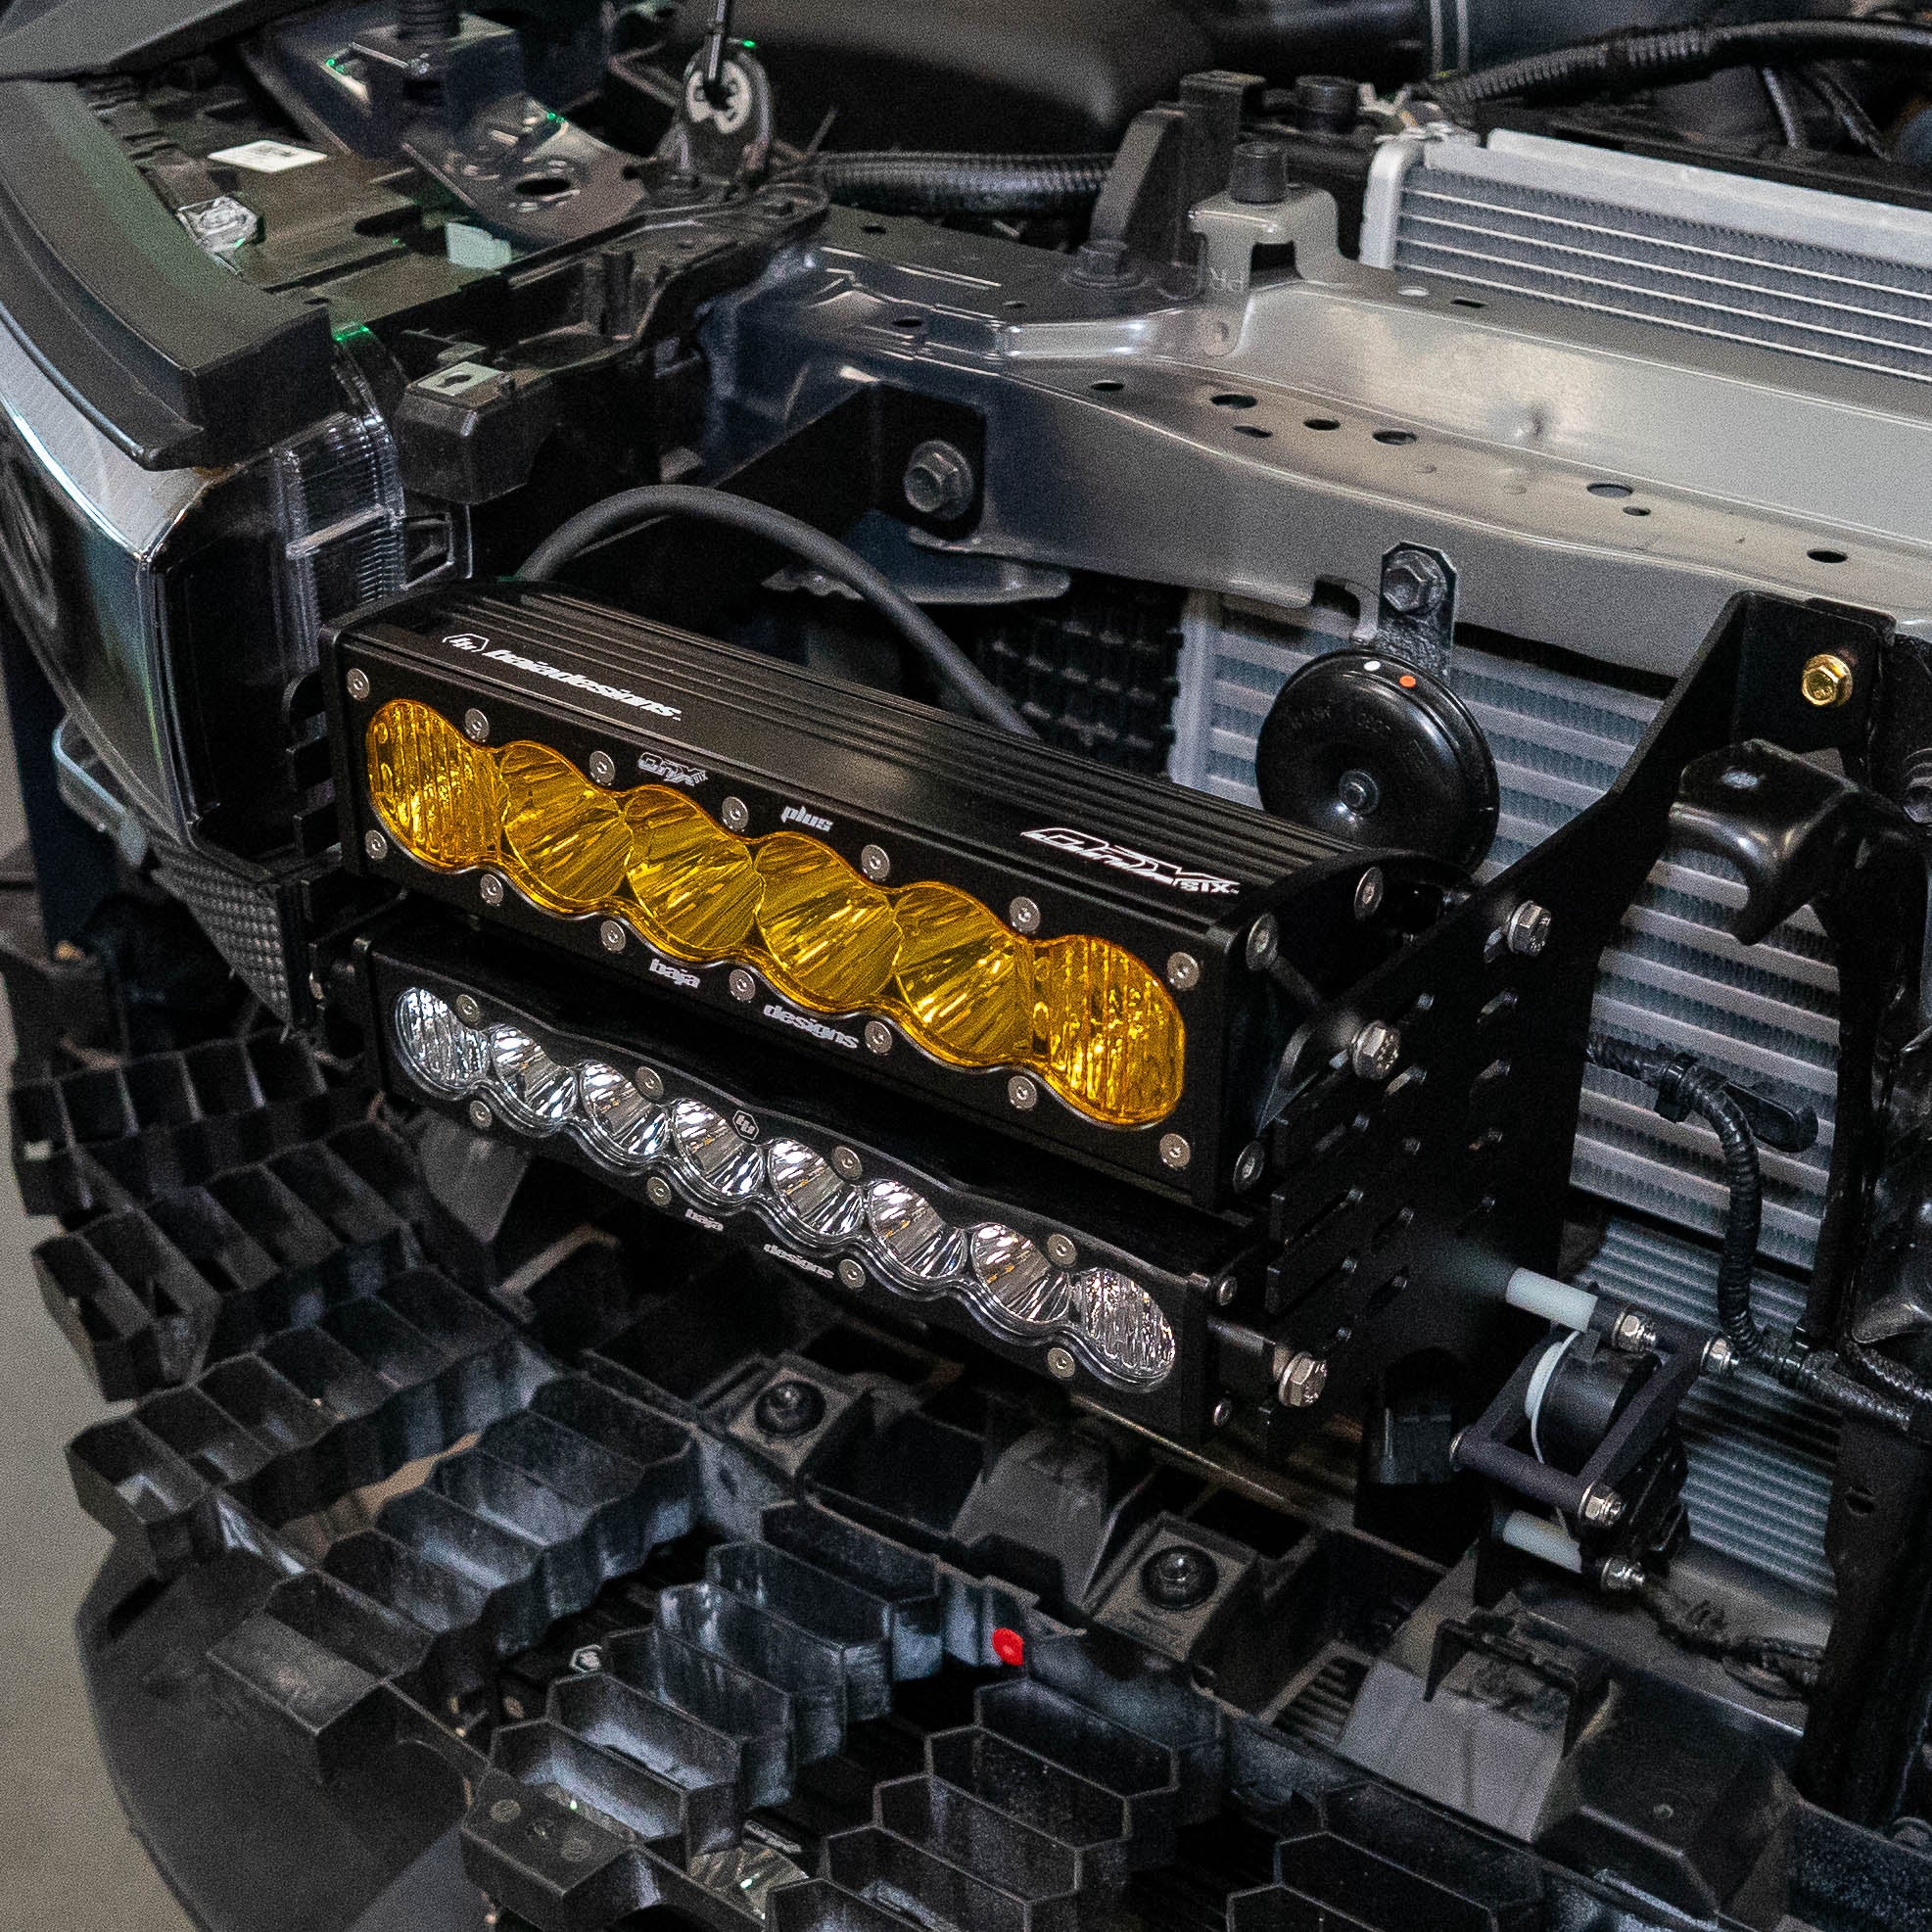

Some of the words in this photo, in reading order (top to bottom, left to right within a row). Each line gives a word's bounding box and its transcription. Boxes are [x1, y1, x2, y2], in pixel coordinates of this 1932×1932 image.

[780, 805, 833, 832] plus
[647, 958, 701, 989] baja
[763, 1003, 860, 1050] designs
[684, 1208, 725, 1232] baja
[763, 1243, 835, 1280] designs
